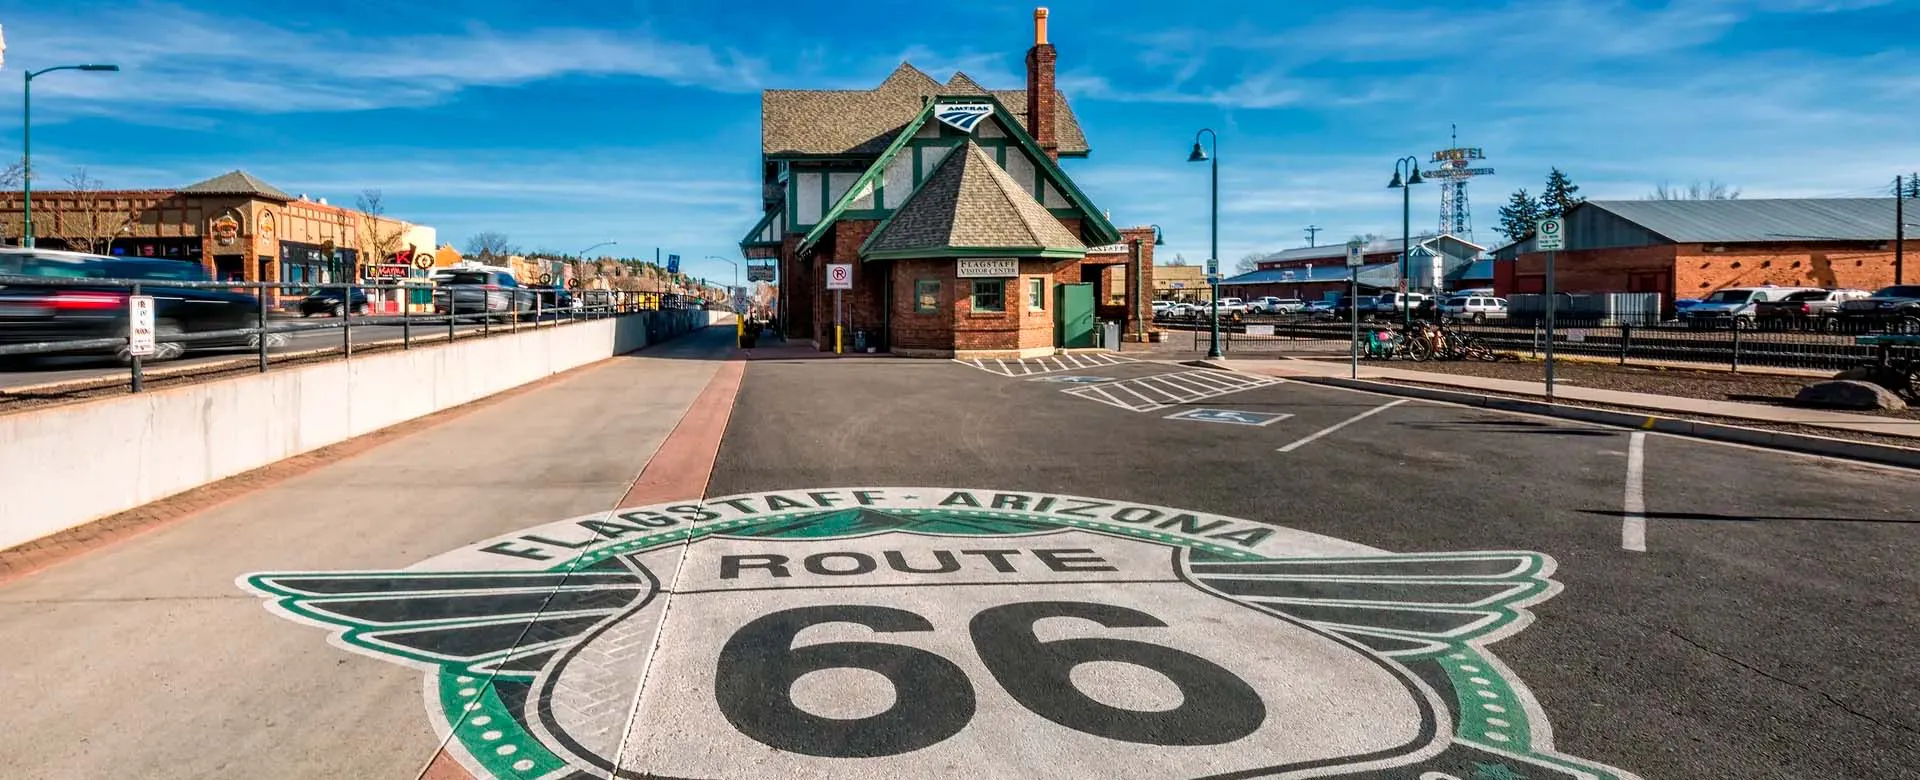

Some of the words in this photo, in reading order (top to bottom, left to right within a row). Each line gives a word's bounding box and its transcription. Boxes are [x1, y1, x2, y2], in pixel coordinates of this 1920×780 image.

[960, 260, 1016, 268] FLAGSTAFF
[477, 489, 886, 562] FLAGSTAFF
[938, 490, 1277, 549] ARIZONA
[719, 547, 1119, 580] ROUTE
[714, 600, 1267, 759] 66
